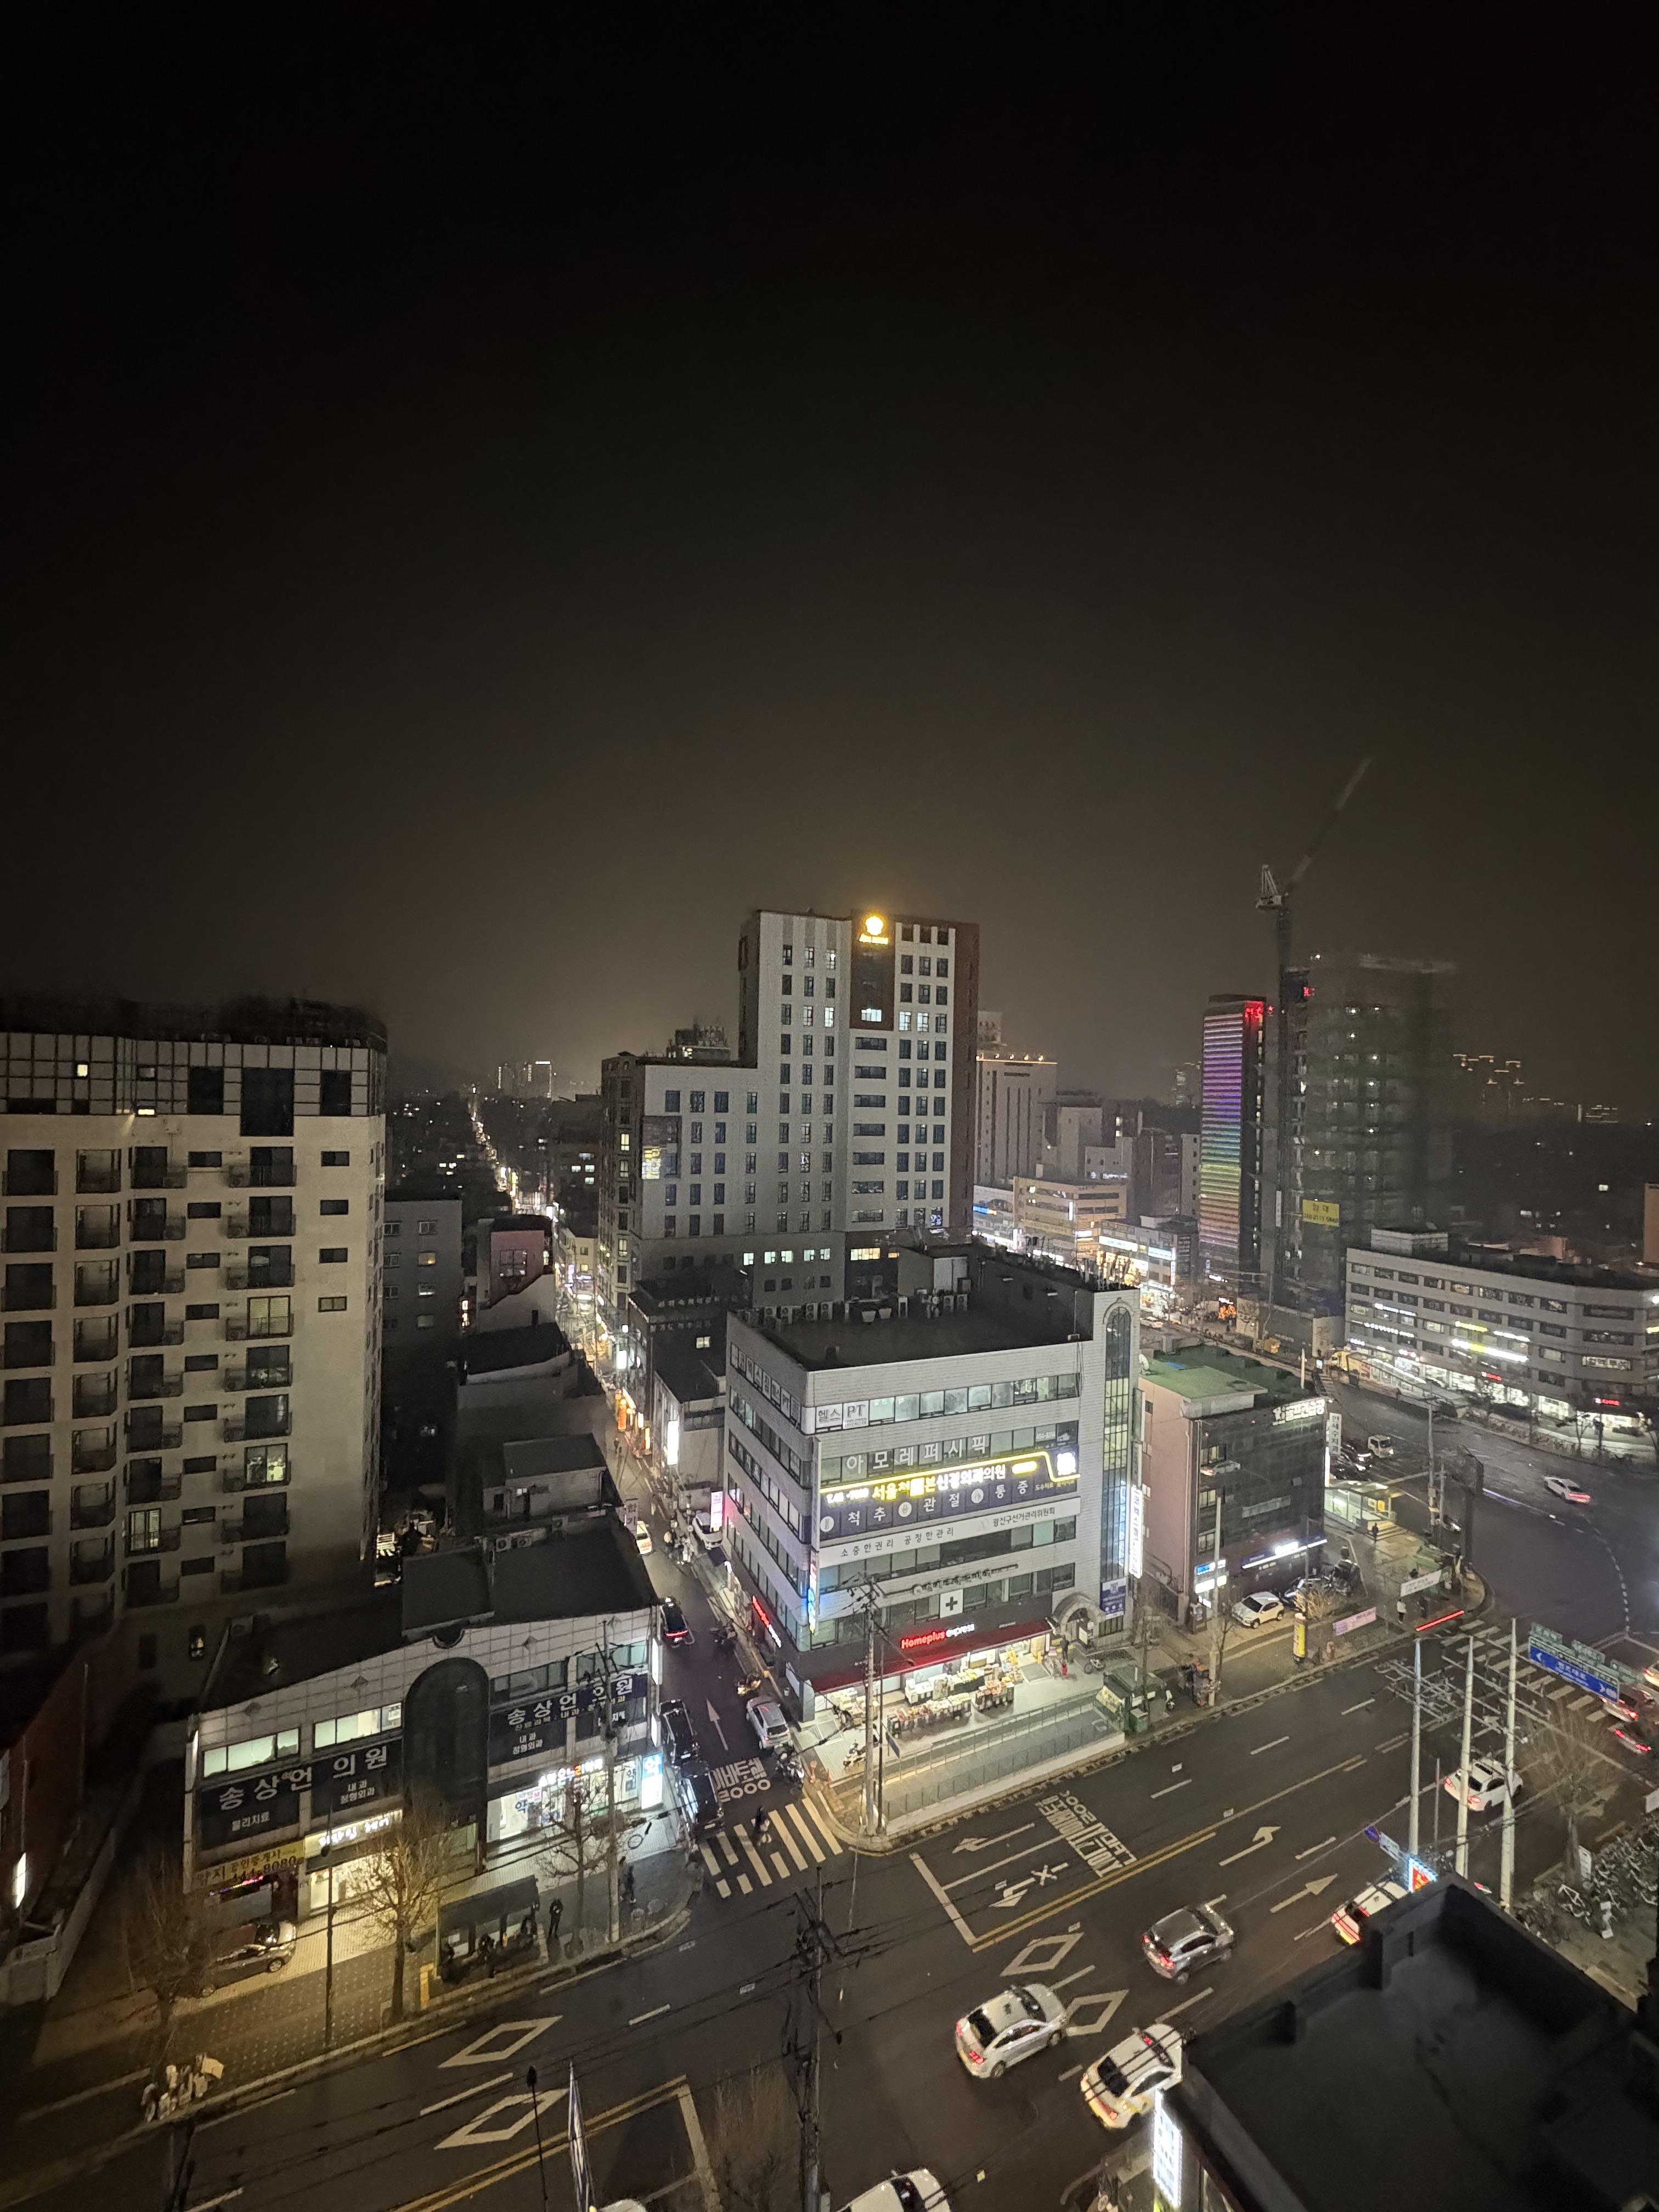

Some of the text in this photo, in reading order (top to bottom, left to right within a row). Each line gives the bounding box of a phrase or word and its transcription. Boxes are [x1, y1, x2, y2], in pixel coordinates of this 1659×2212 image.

[818, 1407, 841, 1423] 헬스
[847, 1404, 866, 1418] PT
[847, 1436, 986, 1474] 아모레퍼시픽
[848, 1481, 1029, 1526] 척추 관절 통증
[992, 1507, 1055, 1527] 광진구선거관리위원회
[901, 1623, 975, 1649] Homeplus express
[508, 1693, 576, 1725] 송상언
[512, 1739, 543, 1755] 정형외과
[519, 1732, 537, 1743] 내과
[219, 1746, 387, 1810] 송상언 의원
[348, 1779, 368, 1792] 내과
[340, 1787, 375, 1805] 정형외과
